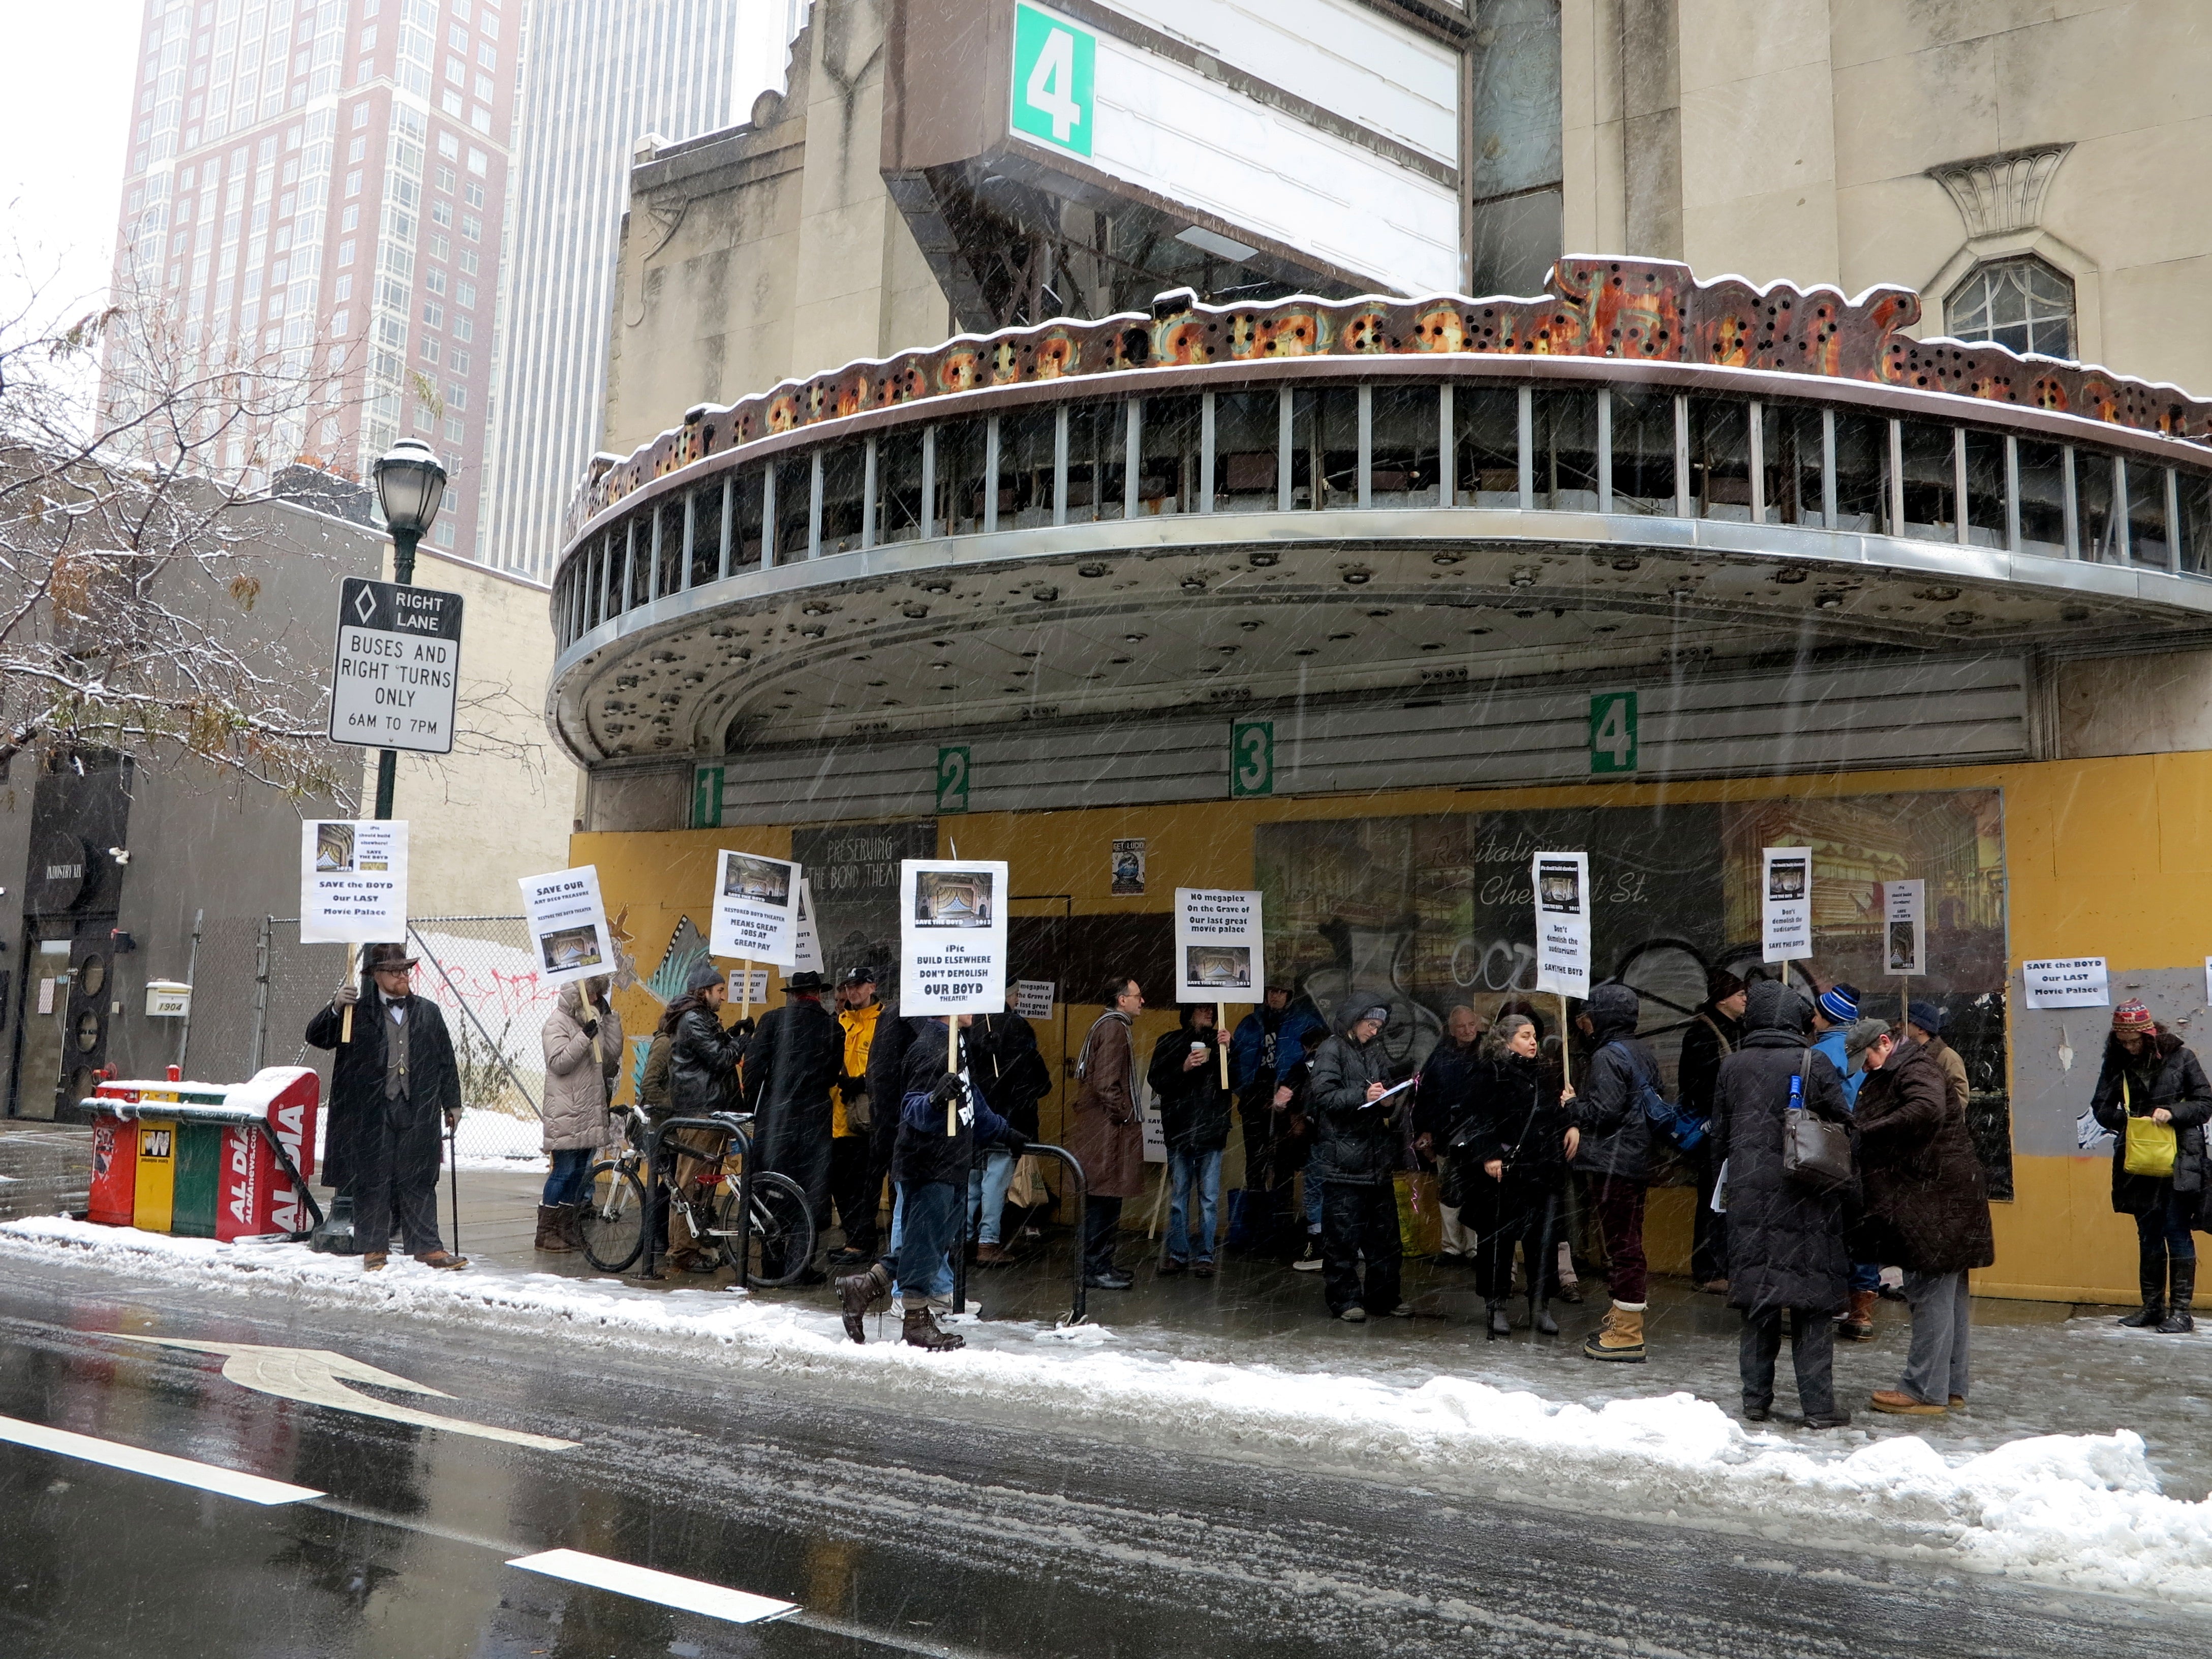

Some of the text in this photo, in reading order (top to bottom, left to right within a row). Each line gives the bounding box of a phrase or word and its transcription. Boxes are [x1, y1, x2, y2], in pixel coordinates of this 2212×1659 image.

[1027, 27, 1081, 142] 4
[395, 592, 443, 611] RIGHT
[396, 612, 439, 631] LANE
[351, 635, 446, 663] BUSES AND
[341, 659, 451, 688] RIGHT TURNS
[375, 687, 416, 708] ONLY
[349, 713, 437, 734] 6AM TO 7PM
[1595, 699, 1632, 765] 4
[1239, 727, 1267, 790] 3
[939, 751, 966, 809] 2
[701, 770, 716, 823] 1
[807, 863, 901, 889] THE BOYD THEAT
[537, 881, 583, 896] SAVE OUR
[562, 890, 589, 900] TREASURE
[1609, 872, 1648, 904] St.
[1204, 895, 1245, 903] megaplex
[724, 907, 749, 915] RESTORED
[764, 913, 785, 922] THEATER
[731, 918, 777, 932] MEANS GREAT
[741, 929, 756, 938] JOBS
[1554, 925, 1567, 933] Don't
[734, 939, 771, 951] GREAT PAY
[1547, 935, 1567, 944] demolish
[945, 944, 965, 953] iPic
[945, 956, 991, 964] ELSEWHERE
[919, 969, 988, 978] DON'T DEMOLISH
[1568, 966, 1583, 976] BOYD
[925, 983, 983, 995] OUR BOYD
[159, 1003, 182, 1011] 1904
[230, 1181, 246, 1224] AL
[272, 1183, 299, 1232] AL
